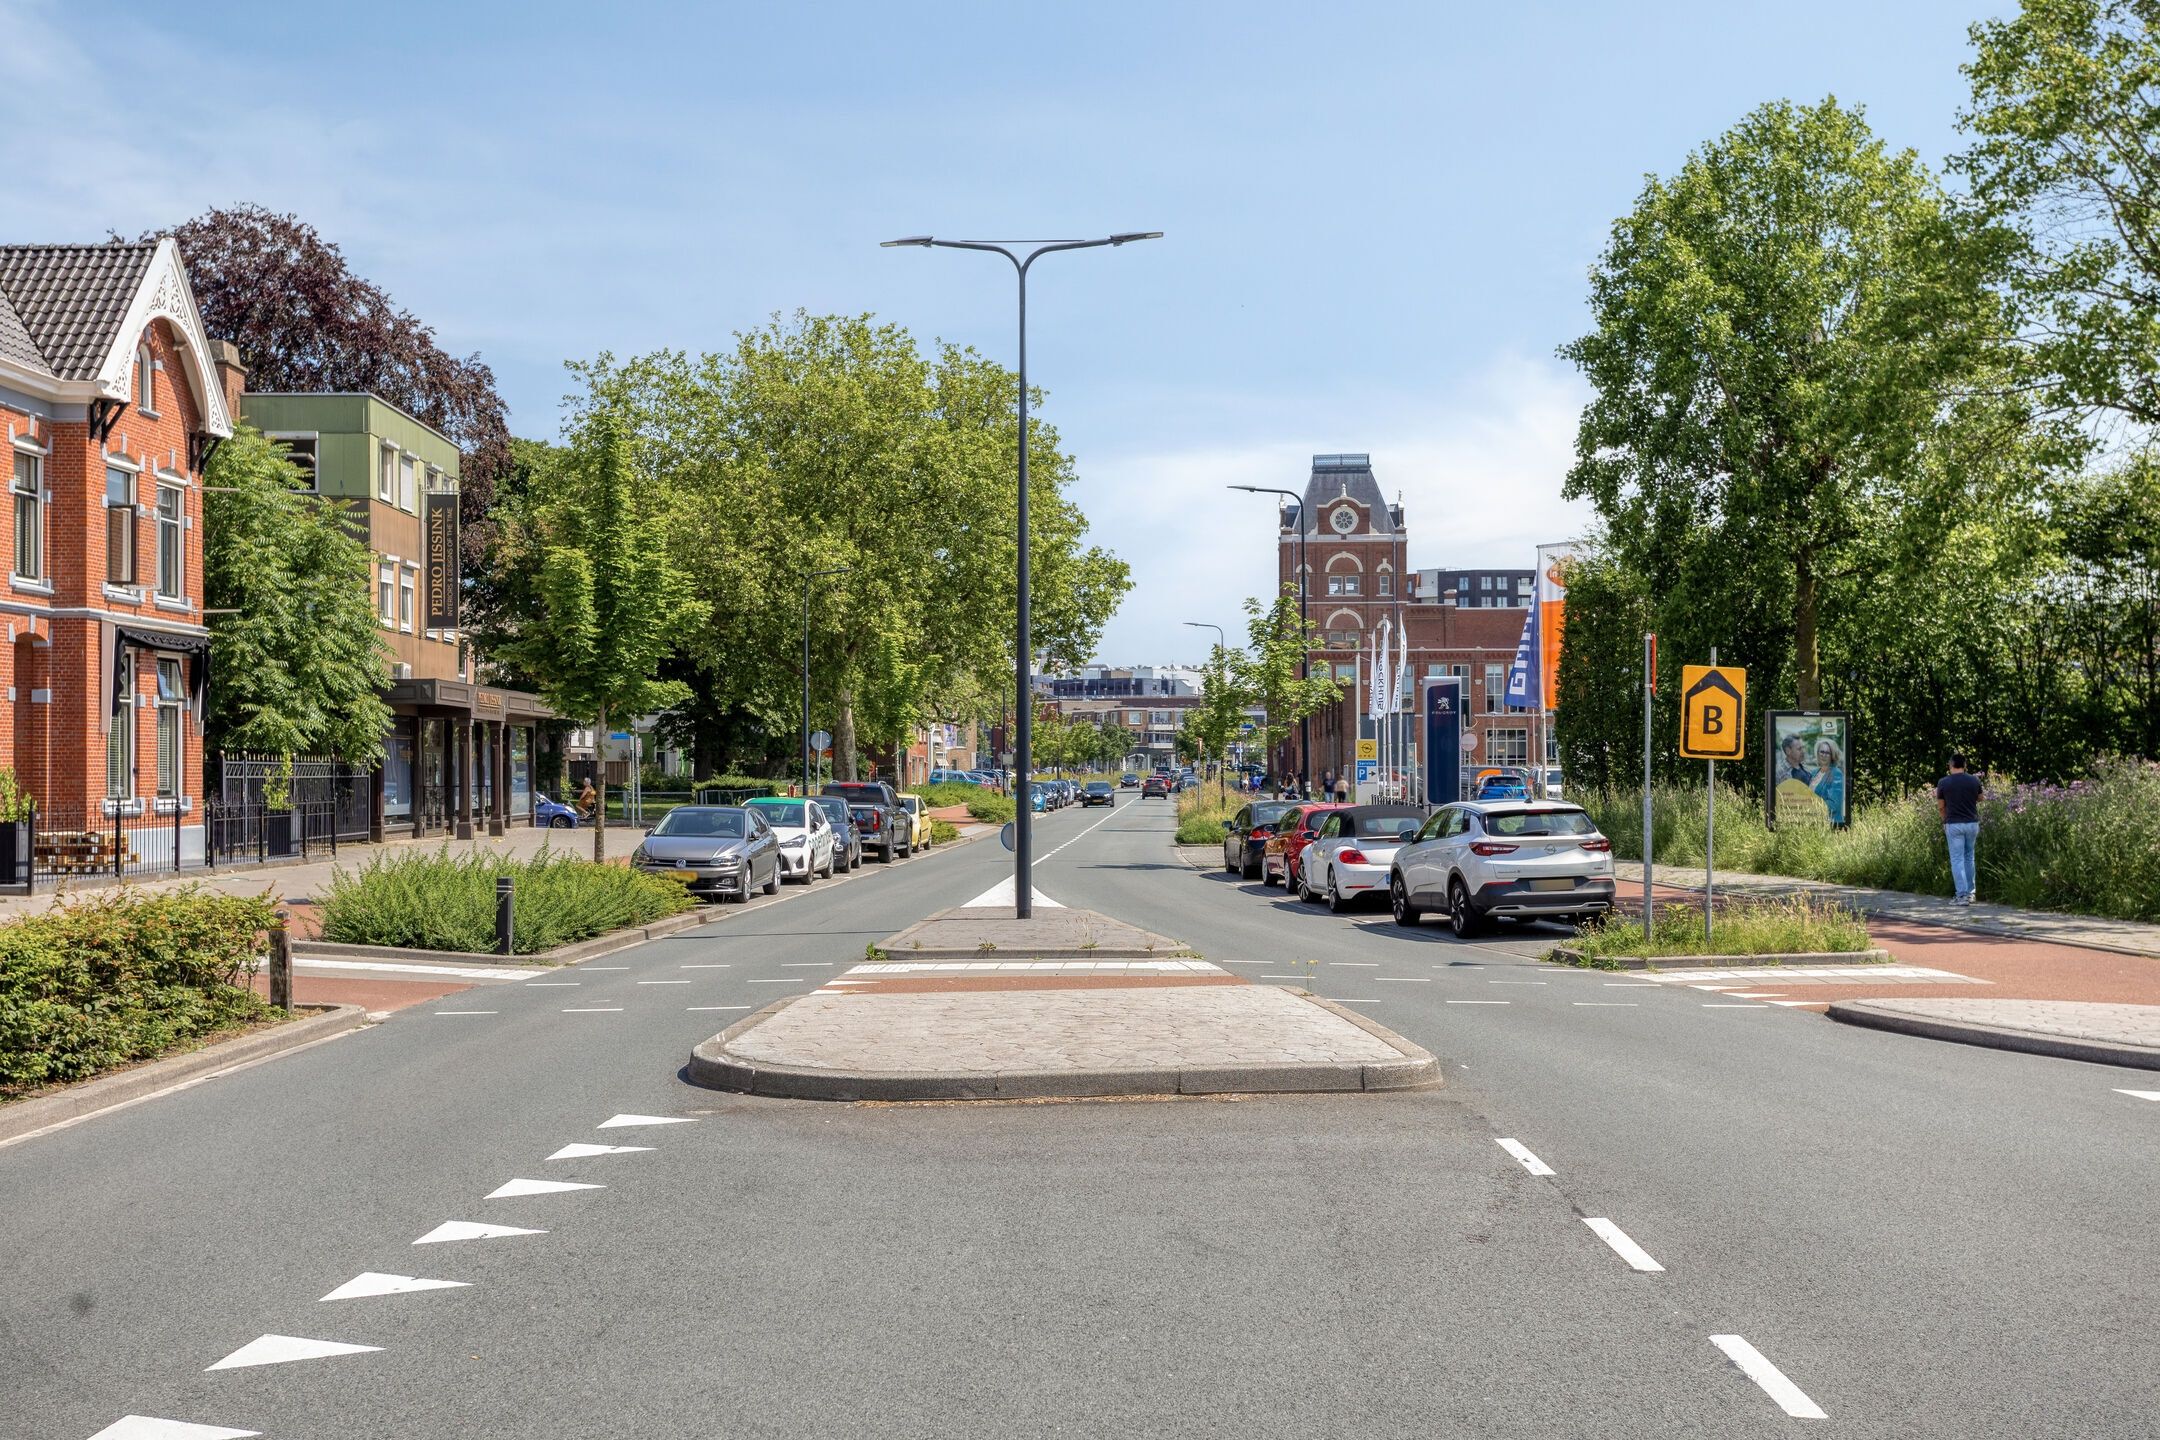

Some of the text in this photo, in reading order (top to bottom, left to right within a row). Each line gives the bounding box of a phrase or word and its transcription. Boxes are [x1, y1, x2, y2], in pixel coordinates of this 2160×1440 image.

[447, 537, 453, 547] OF
[432, 507, 445, 617] PEDRO JISSINK
[1703, 705, 1723, 735] B
[1359, 768, 1366, 779] P
